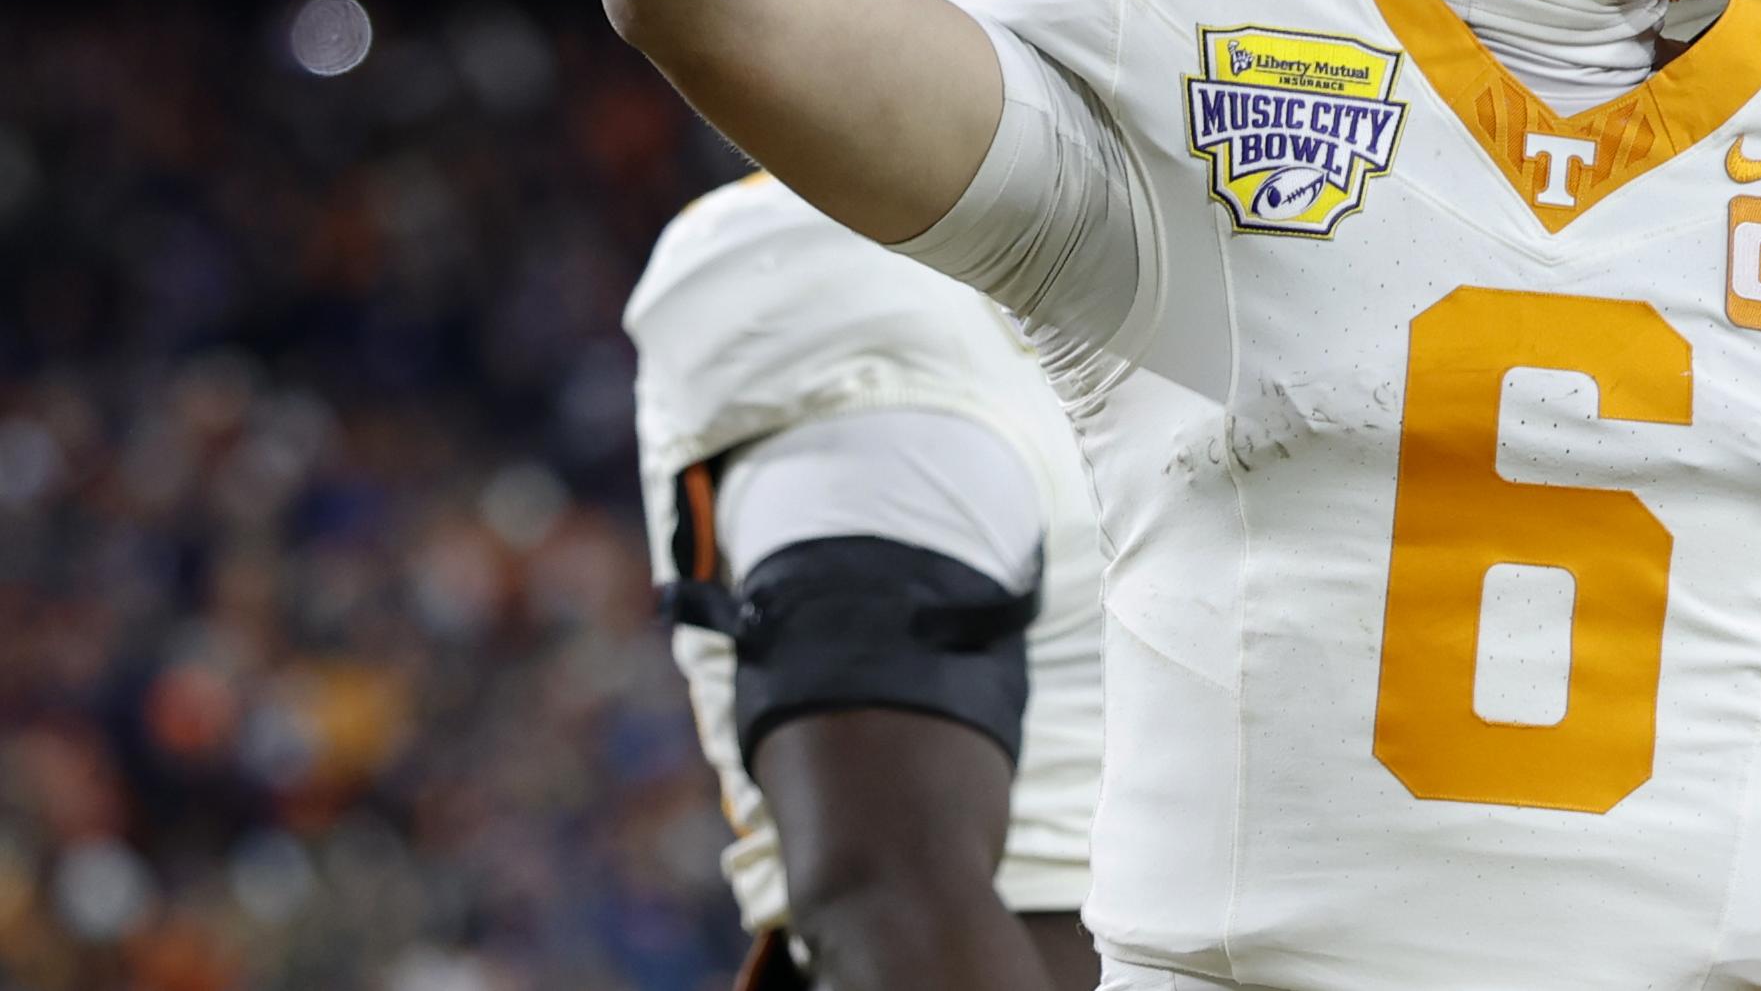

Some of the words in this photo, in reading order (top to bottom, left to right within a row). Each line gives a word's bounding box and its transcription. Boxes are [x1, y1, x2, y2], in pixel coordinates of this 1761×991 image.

[1256, 54, 1311, 76] Liberty
[1314, 62, 1369, 80] Mutual
[1279, 77, 1345, 91] INSURANCE
[1199, 89, 1304, 137] MUSIC
[1310, 101, 1394, 155] CITY
[1238, 133, 1343, 176] BOWL
[1524, 132, 1598, 208] T
[1371, 285, 1693, 815] 6
